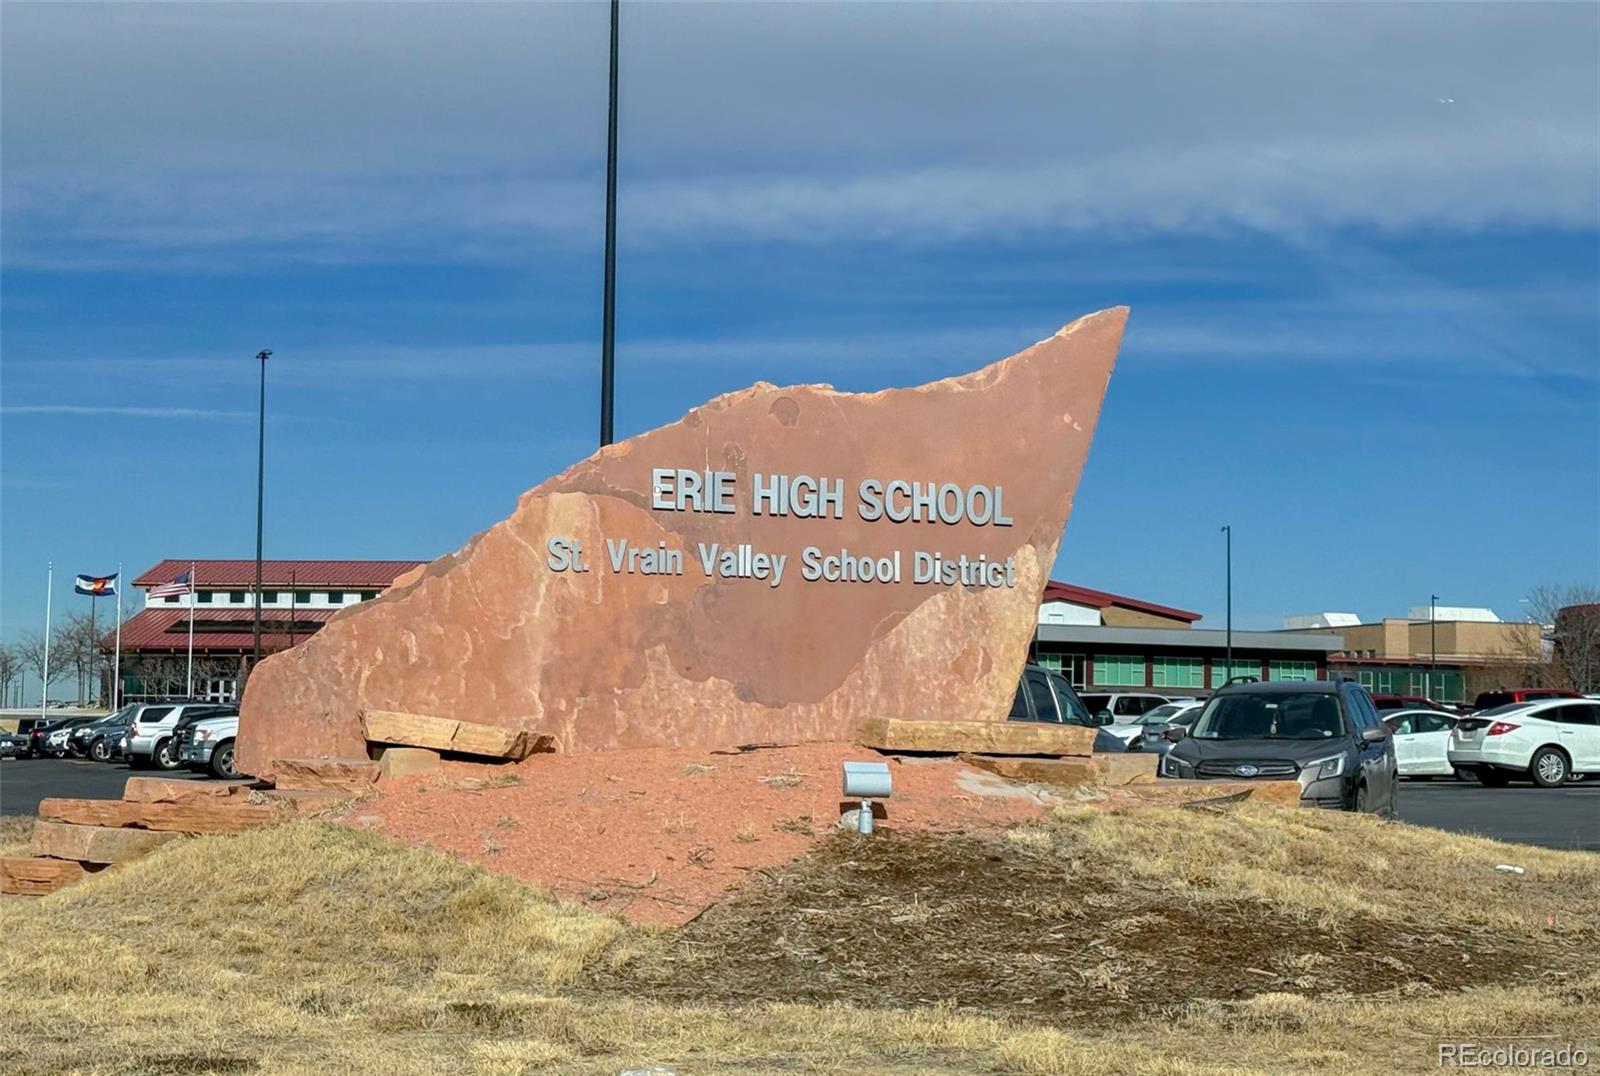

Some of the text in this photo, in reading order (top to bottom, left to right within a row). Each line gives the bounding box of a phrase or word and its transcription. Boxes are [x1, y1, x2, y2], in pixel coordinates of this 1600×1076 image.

[652, 468, 1013, 527] ERIE HIGH SCHOOL
[547, 537, 1016, 588] St. Vrain Valley School District
